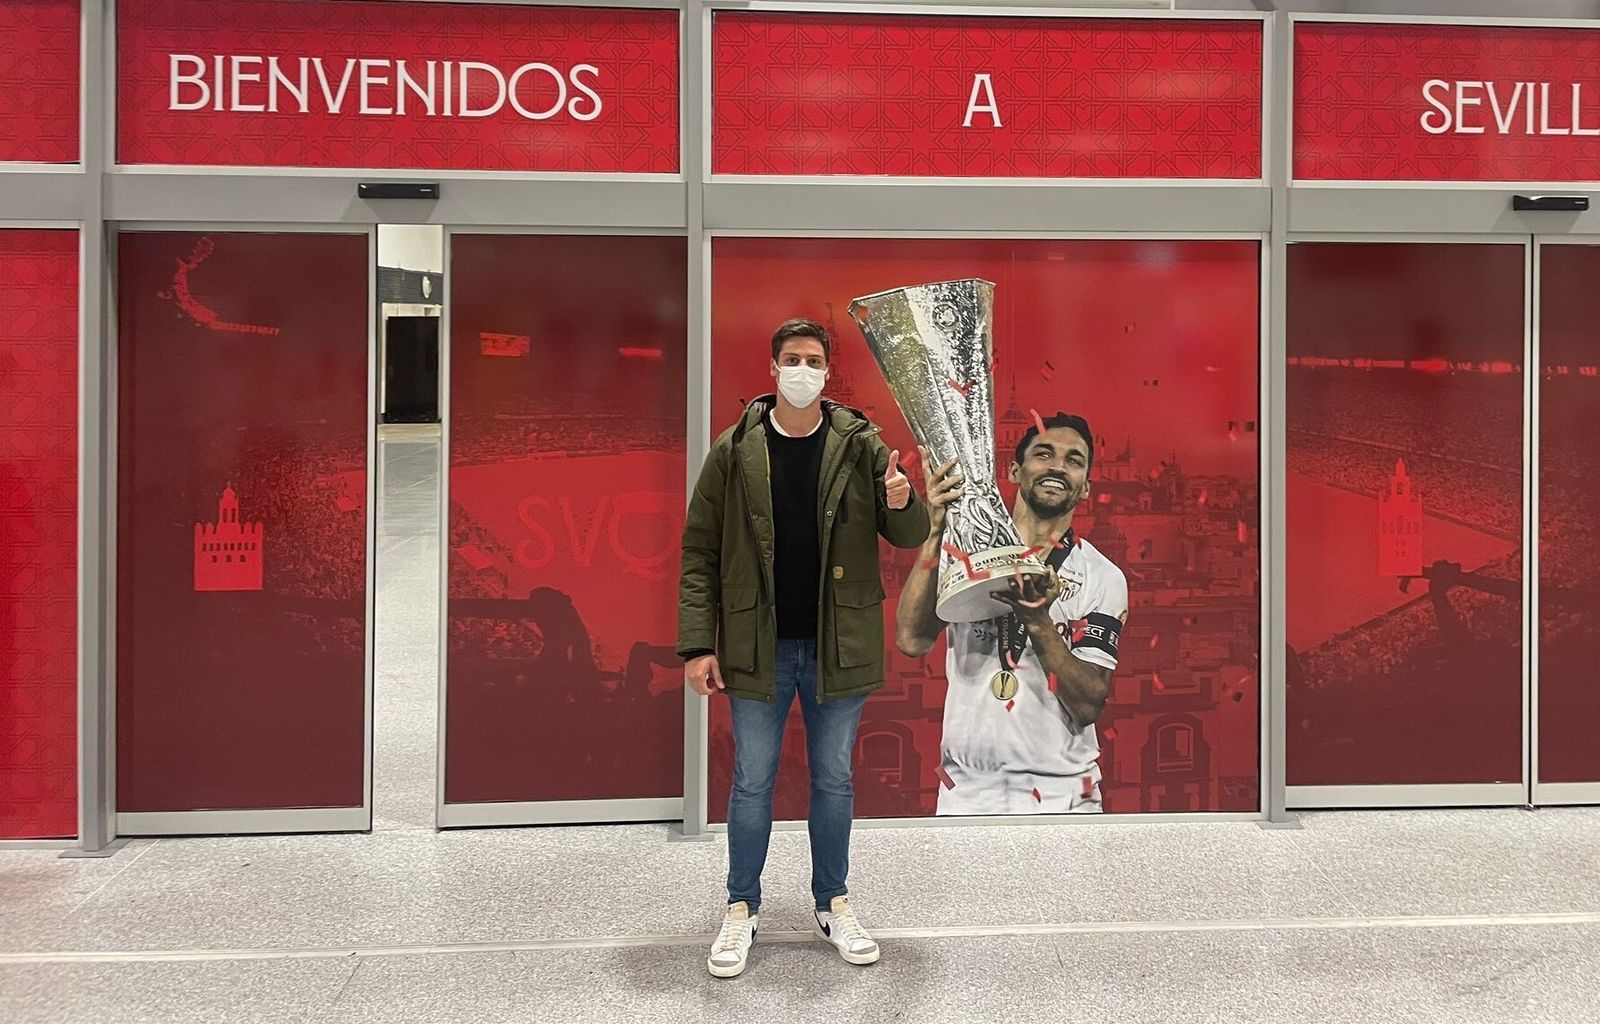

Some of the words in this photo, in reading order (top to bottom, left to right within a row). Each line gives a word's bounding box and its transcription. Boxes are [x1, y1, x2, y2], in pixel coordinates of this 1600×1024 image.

[168, 54, 603, 121] BIENVENIDOS
[961, 73, 1003, 127] A
[1420, 79, 1600, 136] SEVILL
[517, 492, 684, 580] SVQ
